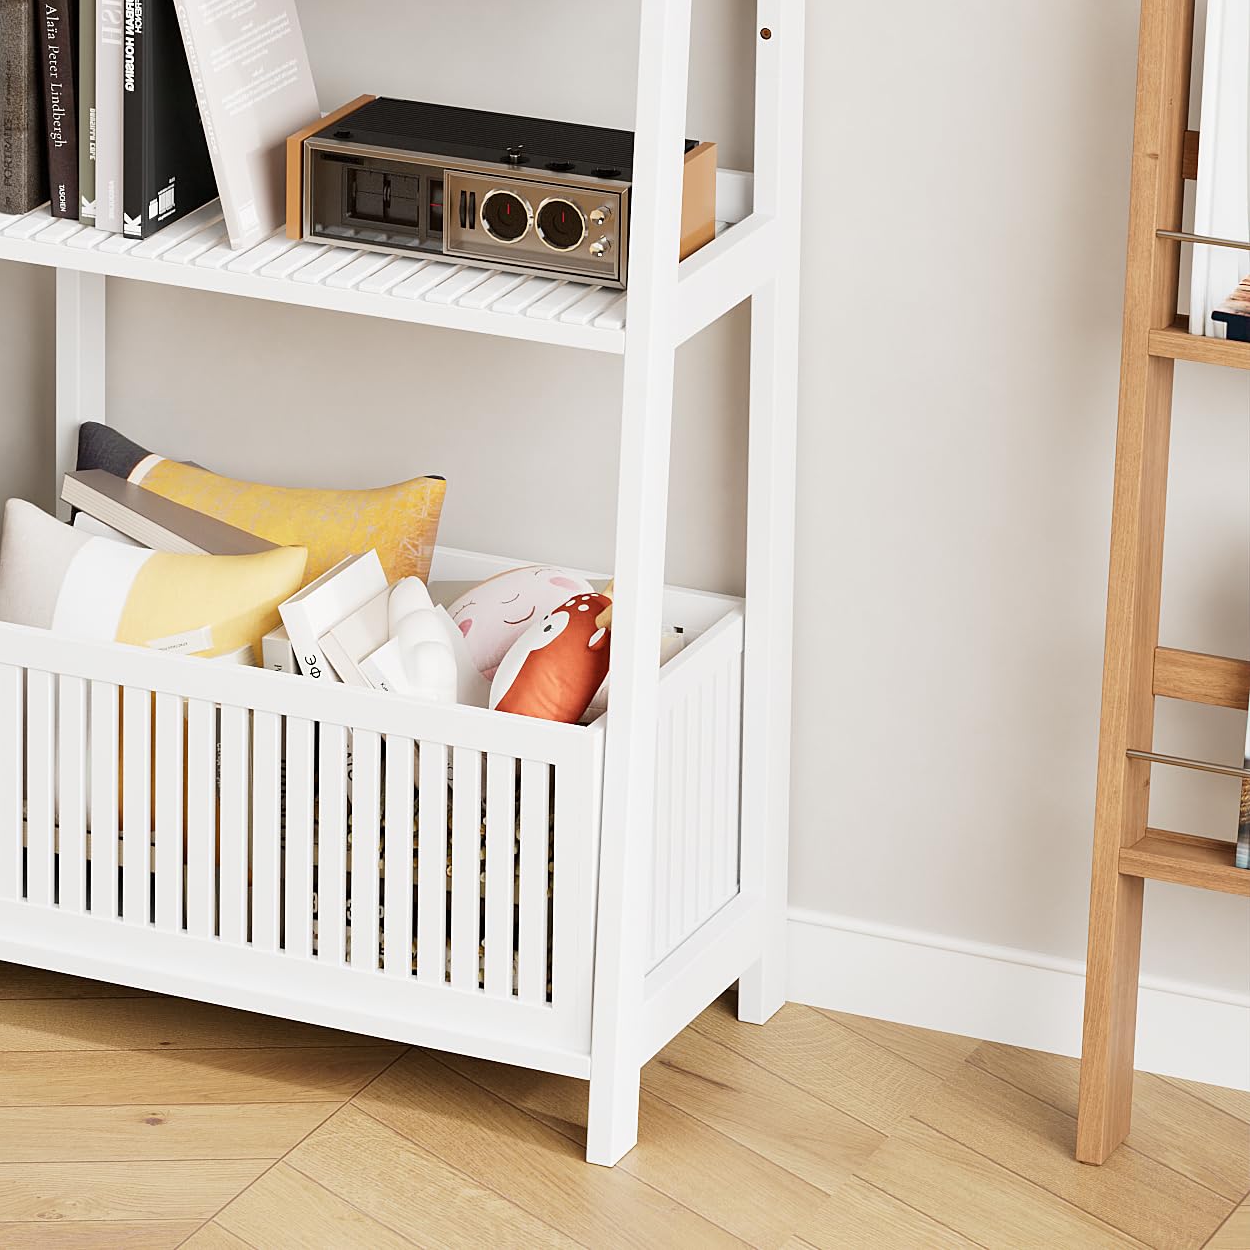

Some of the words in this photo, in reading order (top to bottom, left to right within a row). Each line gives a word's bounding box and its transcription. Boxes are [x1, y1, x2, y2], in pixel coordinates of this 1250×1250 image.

[45, 3, 60, 40] Alaïa
[48, 44, 60, 79] Peter
[50, 83, 67, 148] Lindbergh
[58, 184, 67, 212] TASCHEN
